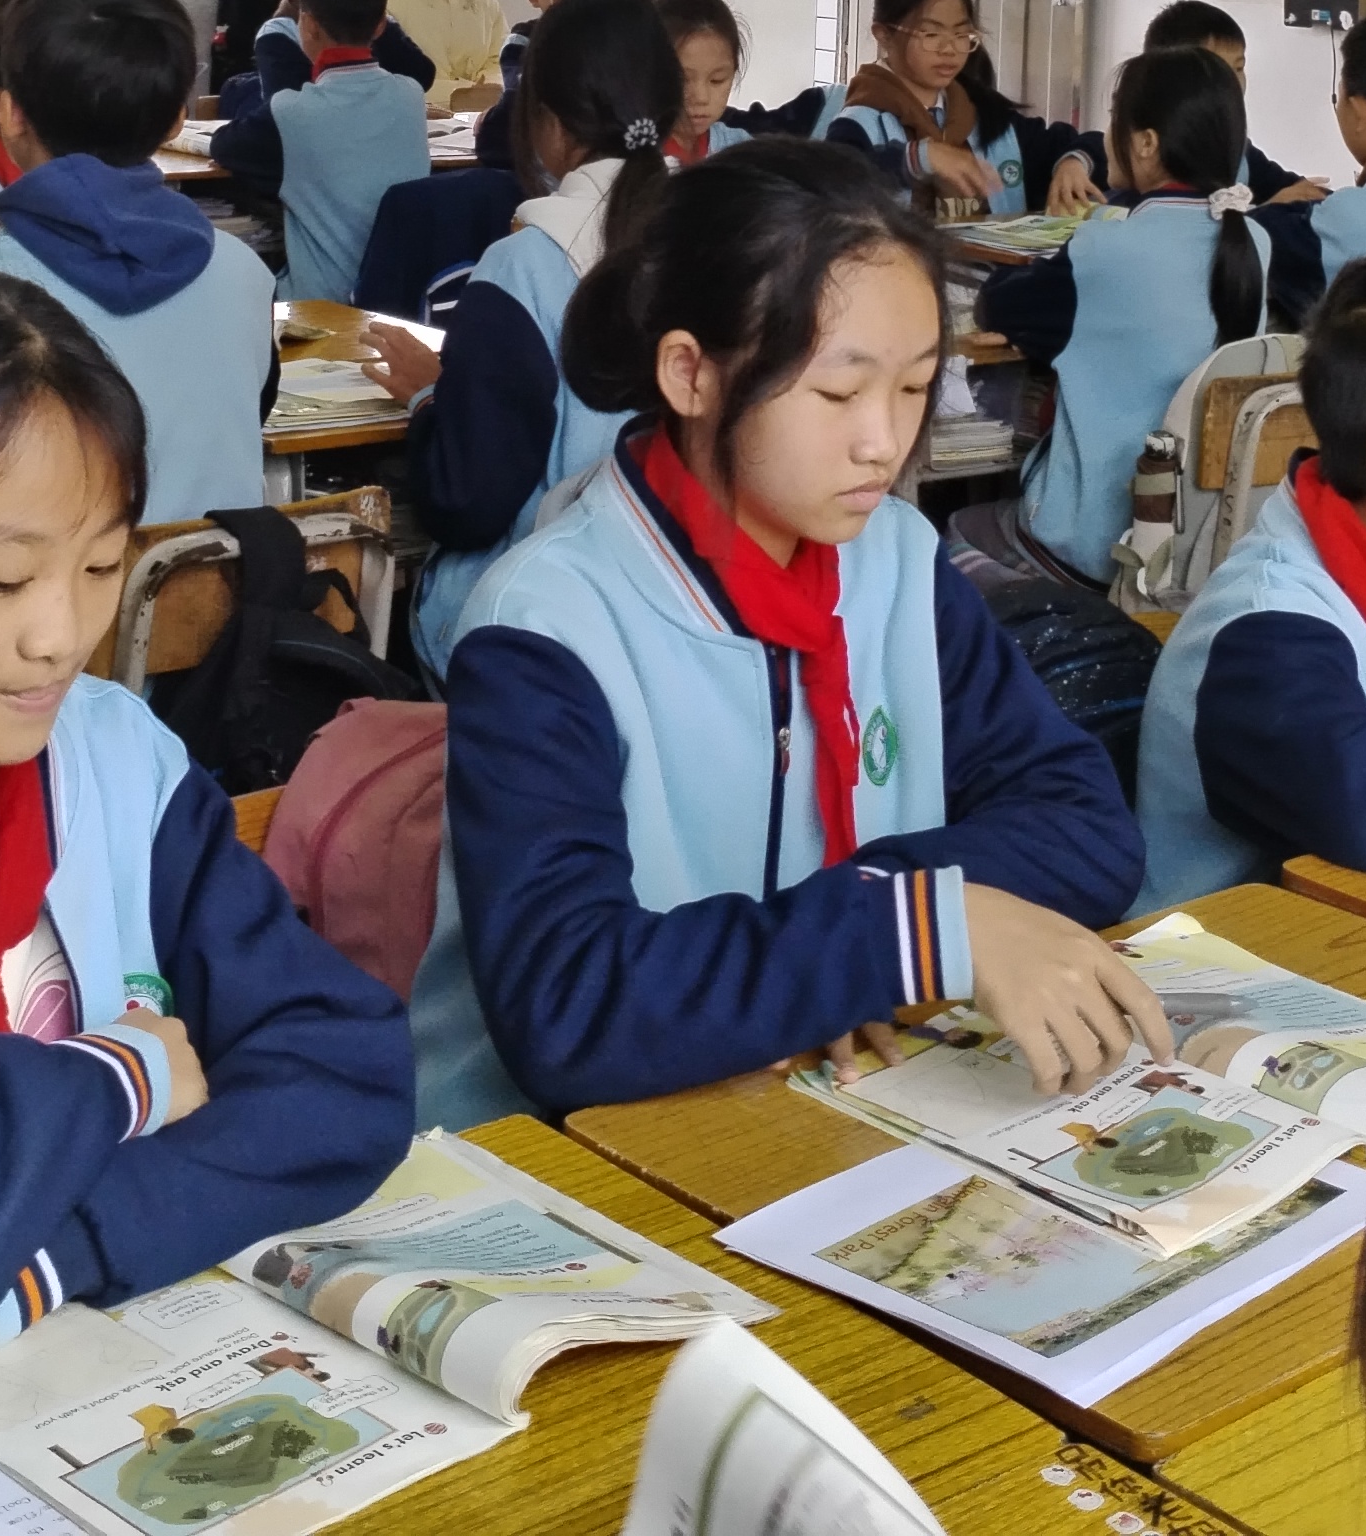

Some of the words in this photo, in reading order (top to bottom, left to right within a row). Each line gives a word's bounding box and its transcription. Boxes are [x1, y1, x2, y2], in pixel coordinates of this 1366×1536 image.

[1111, 1064, 1144, 1085] Draw
[1089, 1084, 1111, 1101] and
[1067, 1100, 1089, 1114] ask
[1274, 1124, 1304, 1142] Let's
[1244, 1141, 1279, 1164] learn
[922, 1180, 987, 1213] ountain
[866, 1211, 927, 1241] Forest
[825, 1238, 873, 1261] Park
[232, 1331, 259, 1344] Draw
[225, 1339, 272, 1360] Draw
[188, 1358, 222, 1378] and
[118, 1382, 140, 1392] talk
[140, 1374, 166, 1384] Then
[153, 1376, 186, 1392] ask
[89, 1391, 119, 1407] about
[34, 1415, 56, 1429] your
[57, 1407, 79, 1419] with
[381, 1430, 424, 1451] Let's
[333, 1447, 384, 1475] learn
